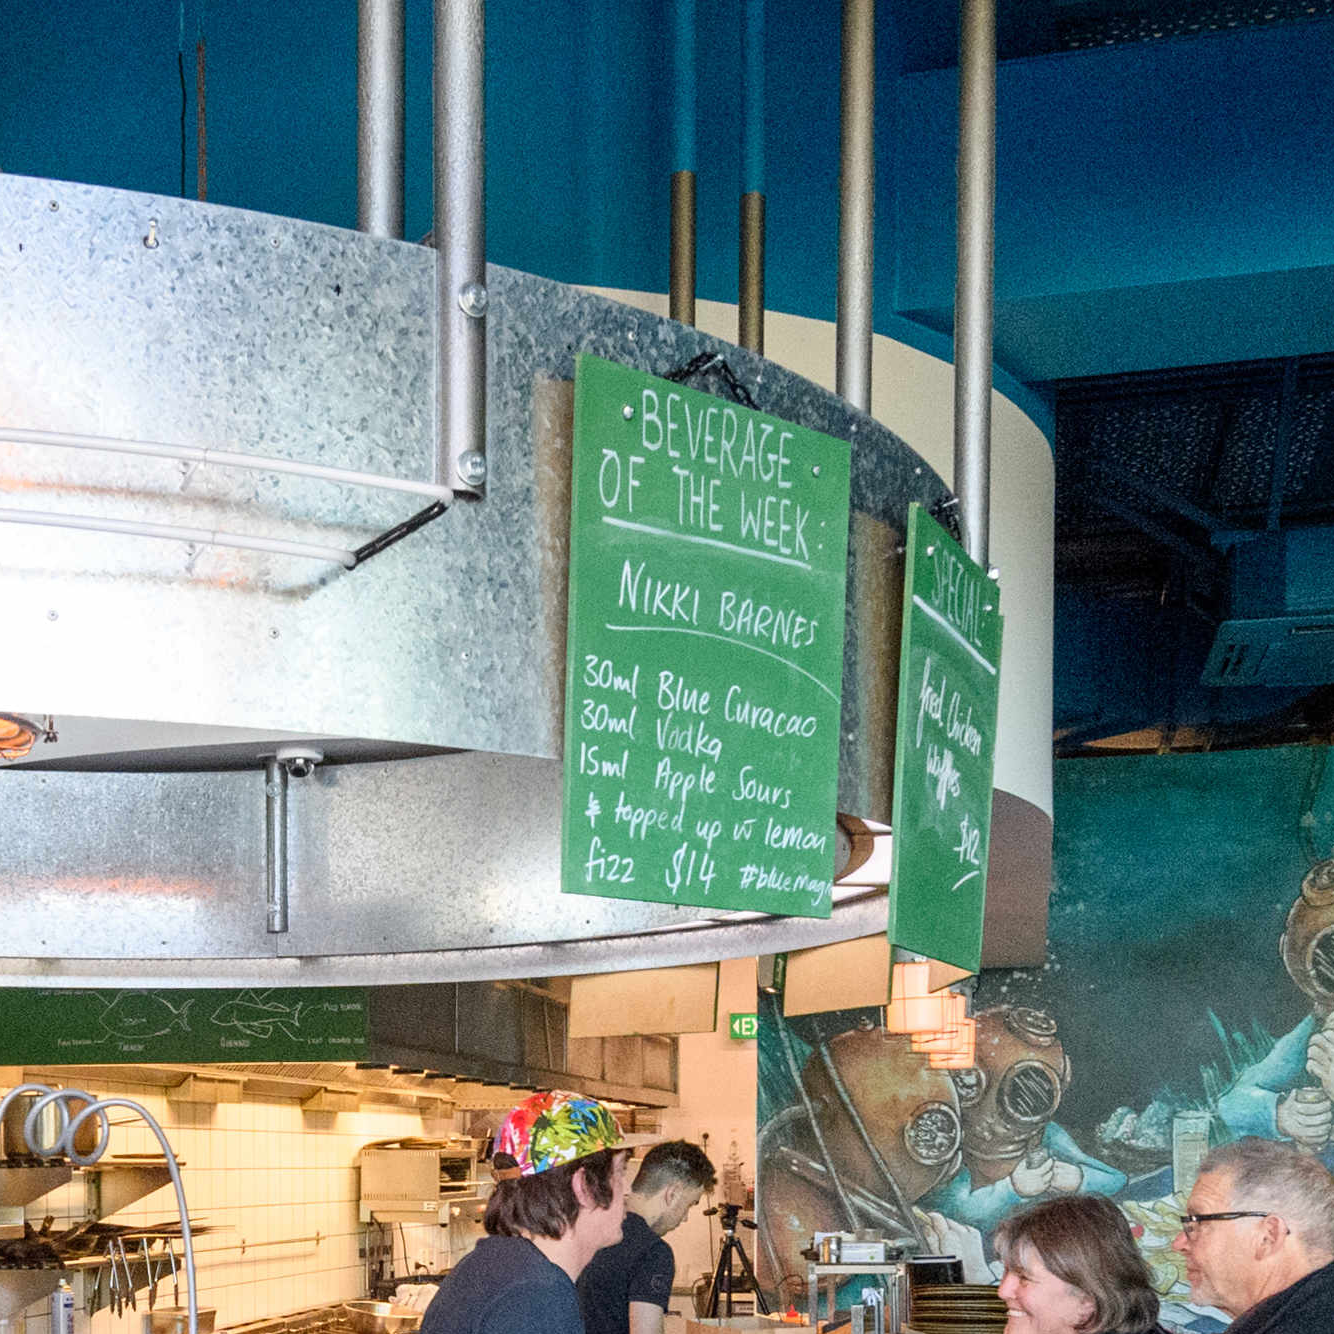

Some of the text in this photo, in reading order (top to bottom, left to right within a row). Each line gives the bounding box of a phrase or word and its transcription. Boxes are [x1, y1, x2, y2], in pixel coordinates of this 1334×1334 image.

[642, 389, 794, 488] BEVERAGE
[599, 448, 645, 513] OF
[672, 464, 723, 531] THE
[619, 559, 819, 648] NIKKI BARNES
[581, 699, 722, 763] 30ml Vodka
[583, 654, 818, 737] 30ml Blue Curacao
[580, 742, 792, 808] 15ml Apple Sours
[615, 791, 684, 840] topped
[696, 820, 722, 849] up
[765, 817, 826, 854] lemon
[666, 842, 716, 895] $14
